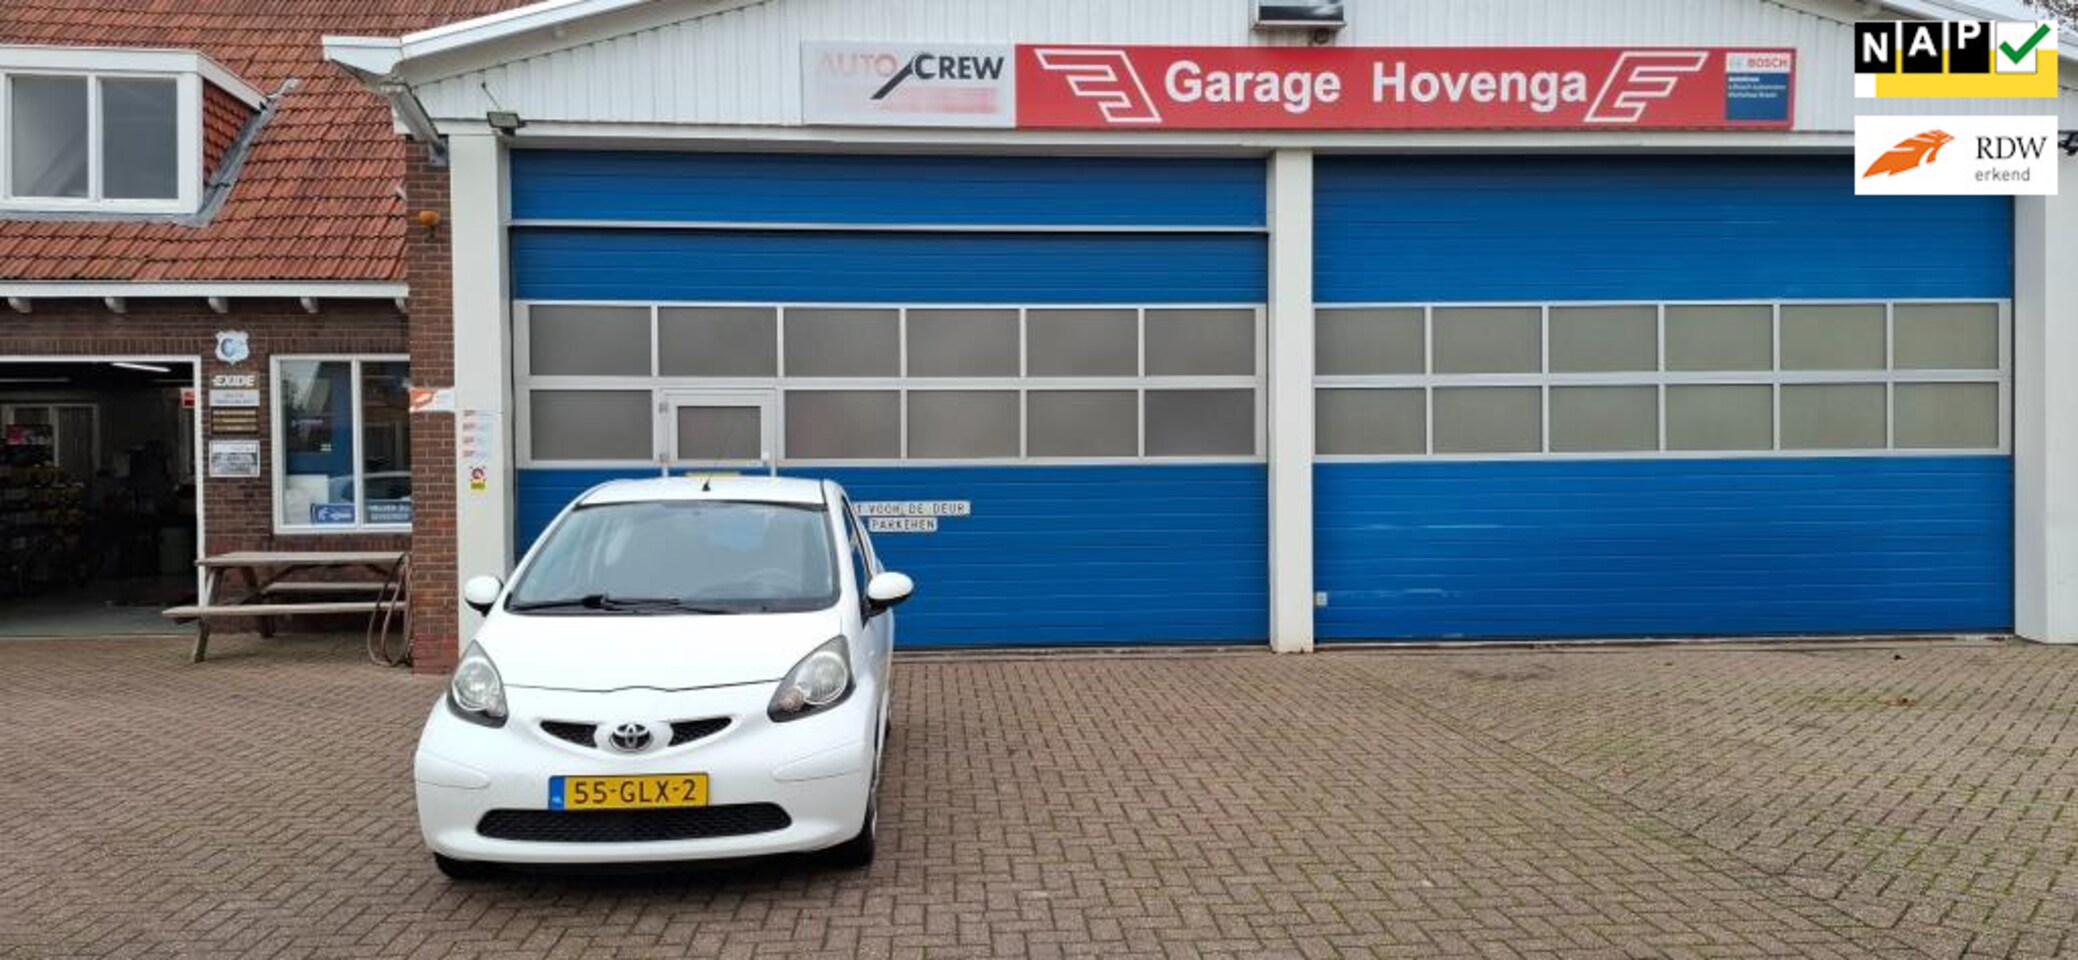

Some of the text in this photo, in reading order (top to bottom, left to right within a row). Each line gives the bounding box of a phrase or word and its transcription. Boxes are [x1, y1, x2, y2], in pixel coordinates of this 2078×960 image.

[817, 53, 1005, 80] AUTO CREW
[1747, 57, 1788, 68] BOSCH
[1164, 60, 1588, 113] Garage Hovenga
[212, 374, 256, 387] EXIDE
[908, 502, 925, 515] DE
[932, 502, 966, 515] DEUR
[573, 778, 697, 804] 55-GLX-2
